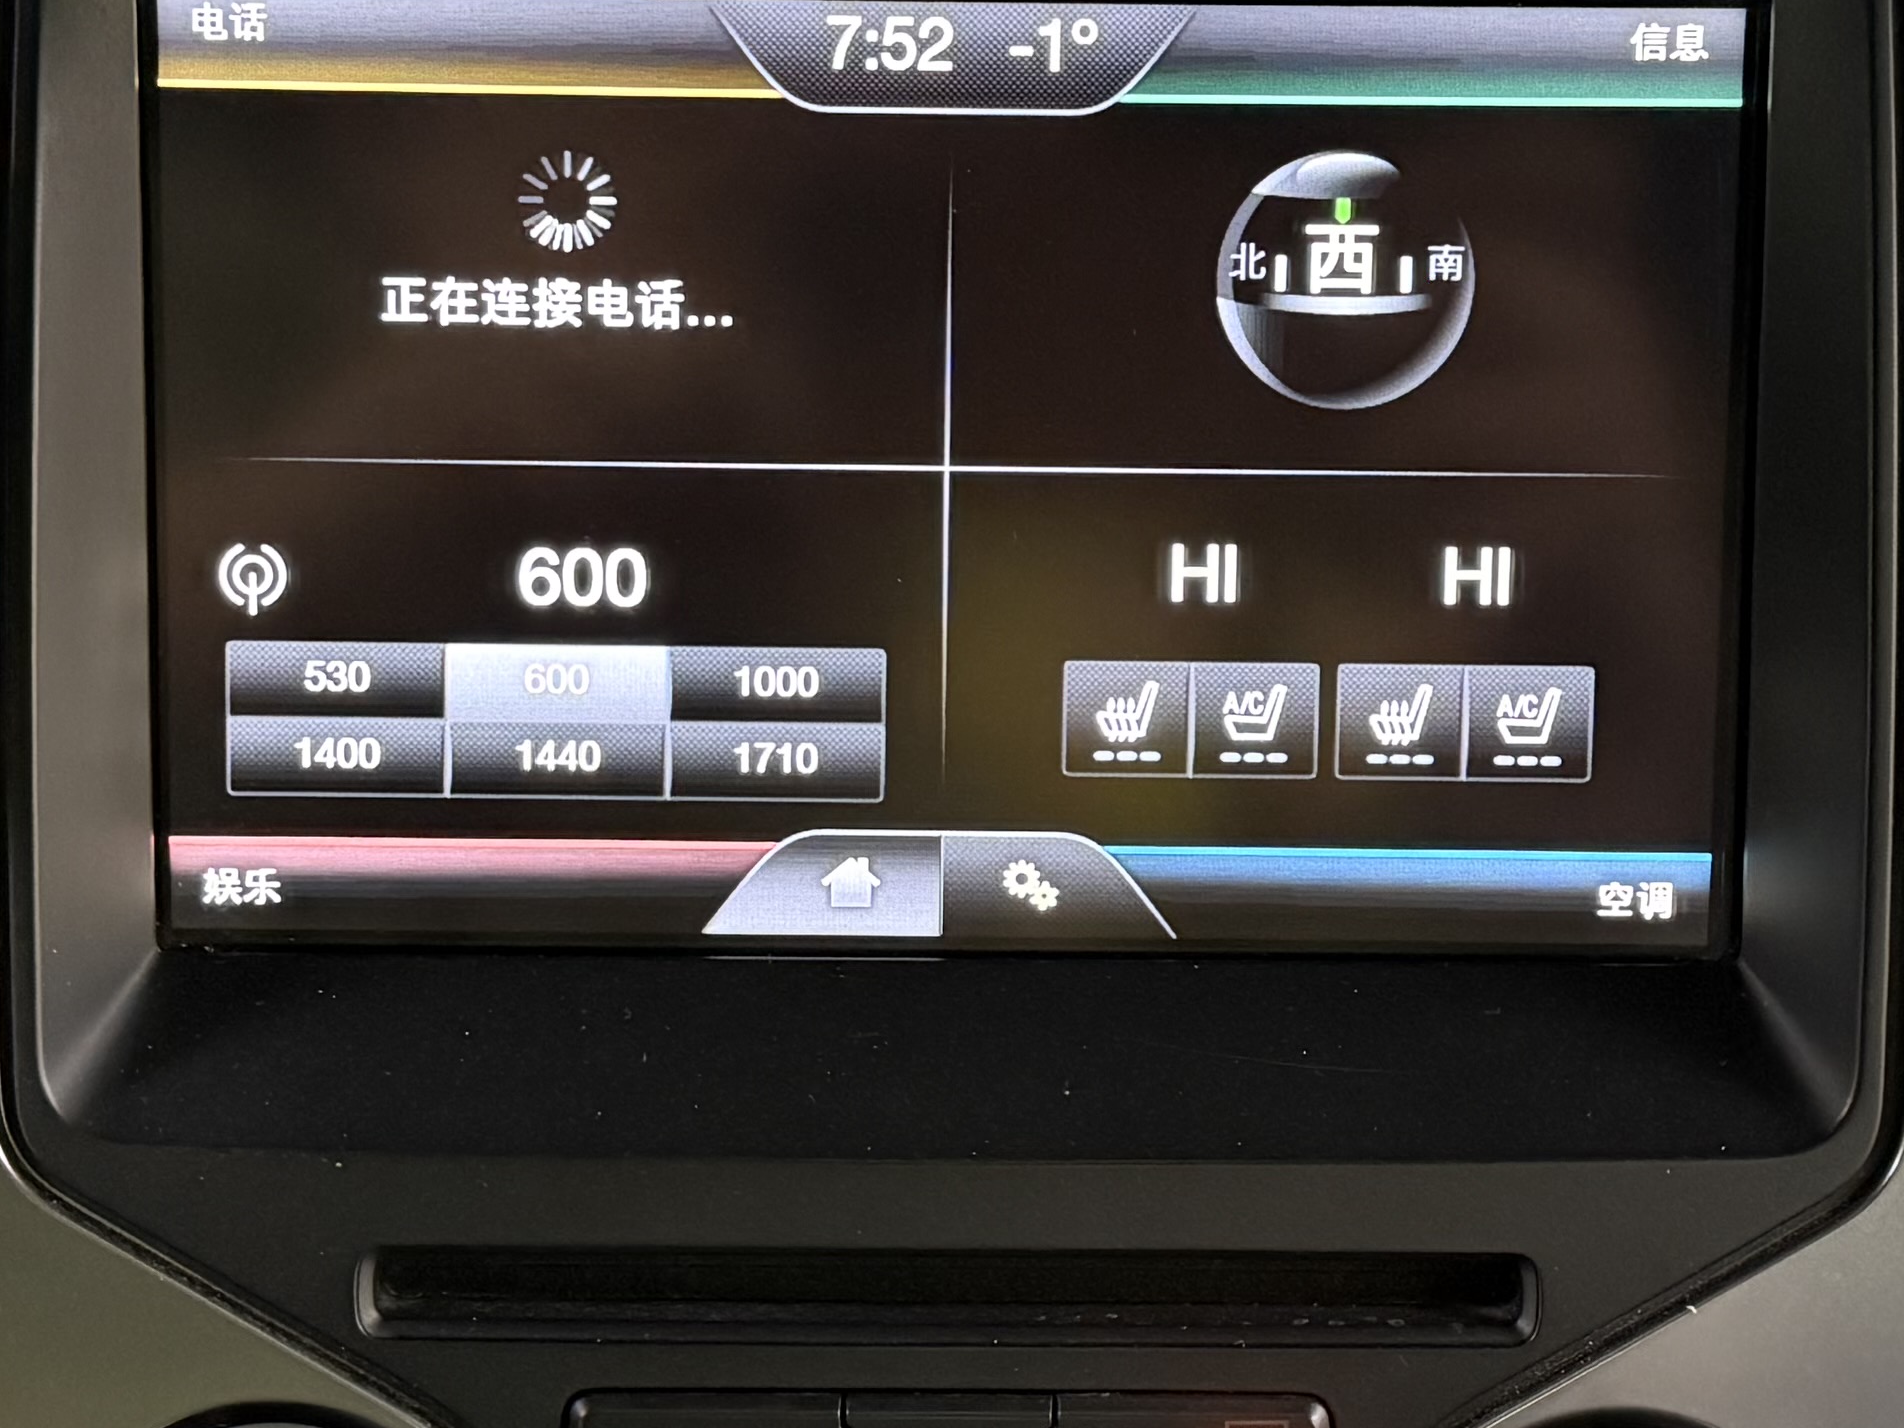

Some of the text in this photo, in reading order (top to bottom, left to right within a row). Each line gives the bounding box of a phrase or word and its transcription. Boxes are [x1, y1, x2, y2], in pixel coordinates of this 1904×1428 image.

[189, 1, 268, 42] 电话
[825, 14, 1100, 75] 7:52 -1°
[1629, 21, 1710, 63] 信息
[1229, 223, 1467, 296] 北 西 南
[380, 276, 734, 331] 正在连接电话...
[517, 546, 649, 609] 600
[1169, 542, 1239, 604] HI
[1442, 546, 1513, 607] HI
[302, 659, 372, 694] 530
[523, 662, 590, 697] 600
[733, 665, 820, 699] 1000
[1223, 691, 1266, 718] A/C
[1497, 693, 1540, 720] A/C
[294, 736, 382, 771] 1400
[515, 739, 602, 774] 1440
[733, 742, 819, 776] 1710
[203, 866, 282, 907] 娱乐
[1596, 881, 1675, 921] 空调
